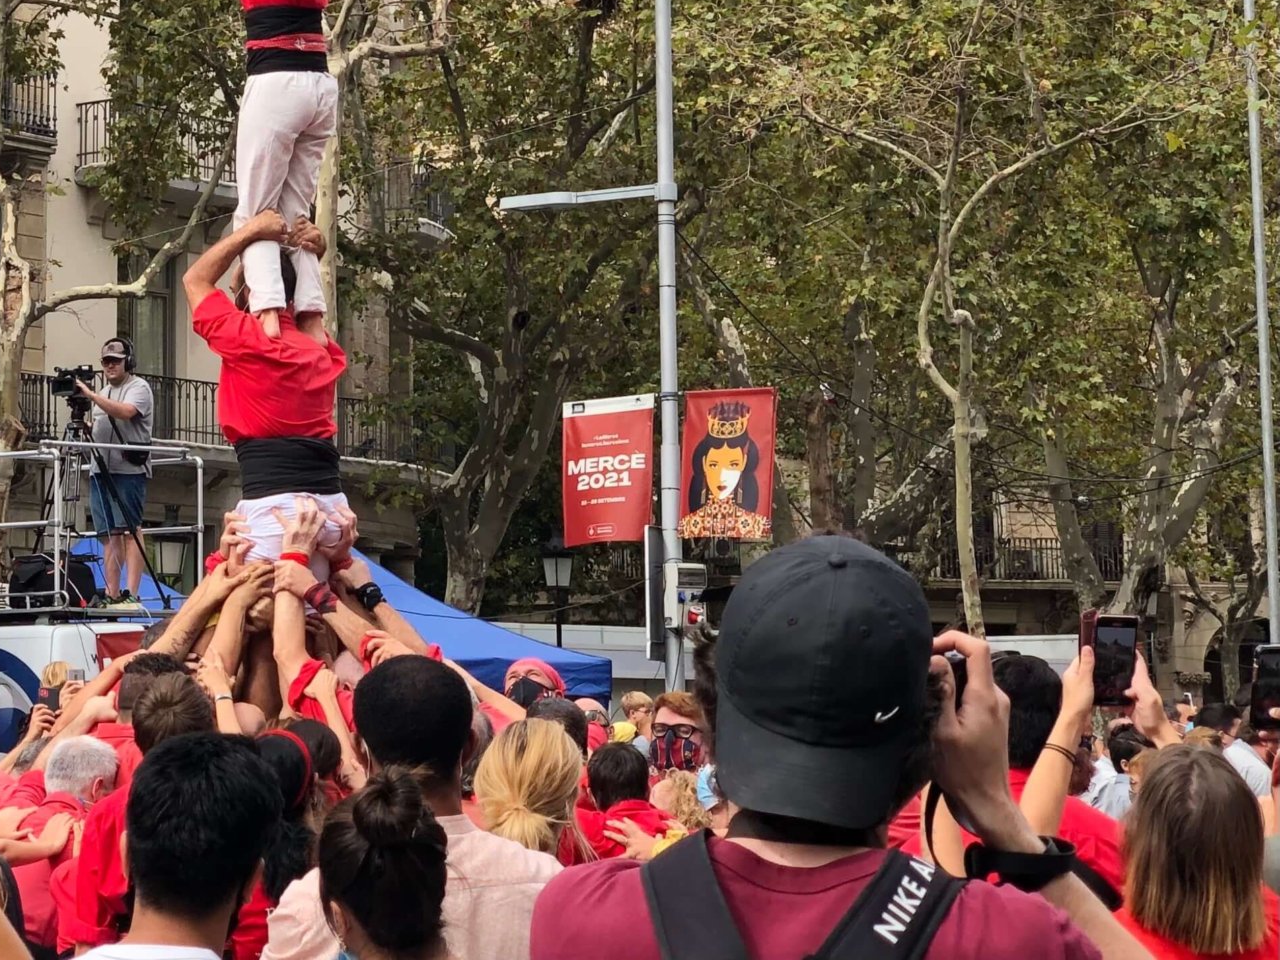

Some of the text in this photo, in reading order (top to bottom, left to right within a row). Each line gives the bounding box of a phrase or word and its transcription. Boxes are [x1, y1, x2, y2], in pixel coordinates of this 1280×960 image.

[568, 450, 646, 475] MERCÈ
[577, 471, 632, 491] 2021
[873, 875, 927, 944] NIKE
